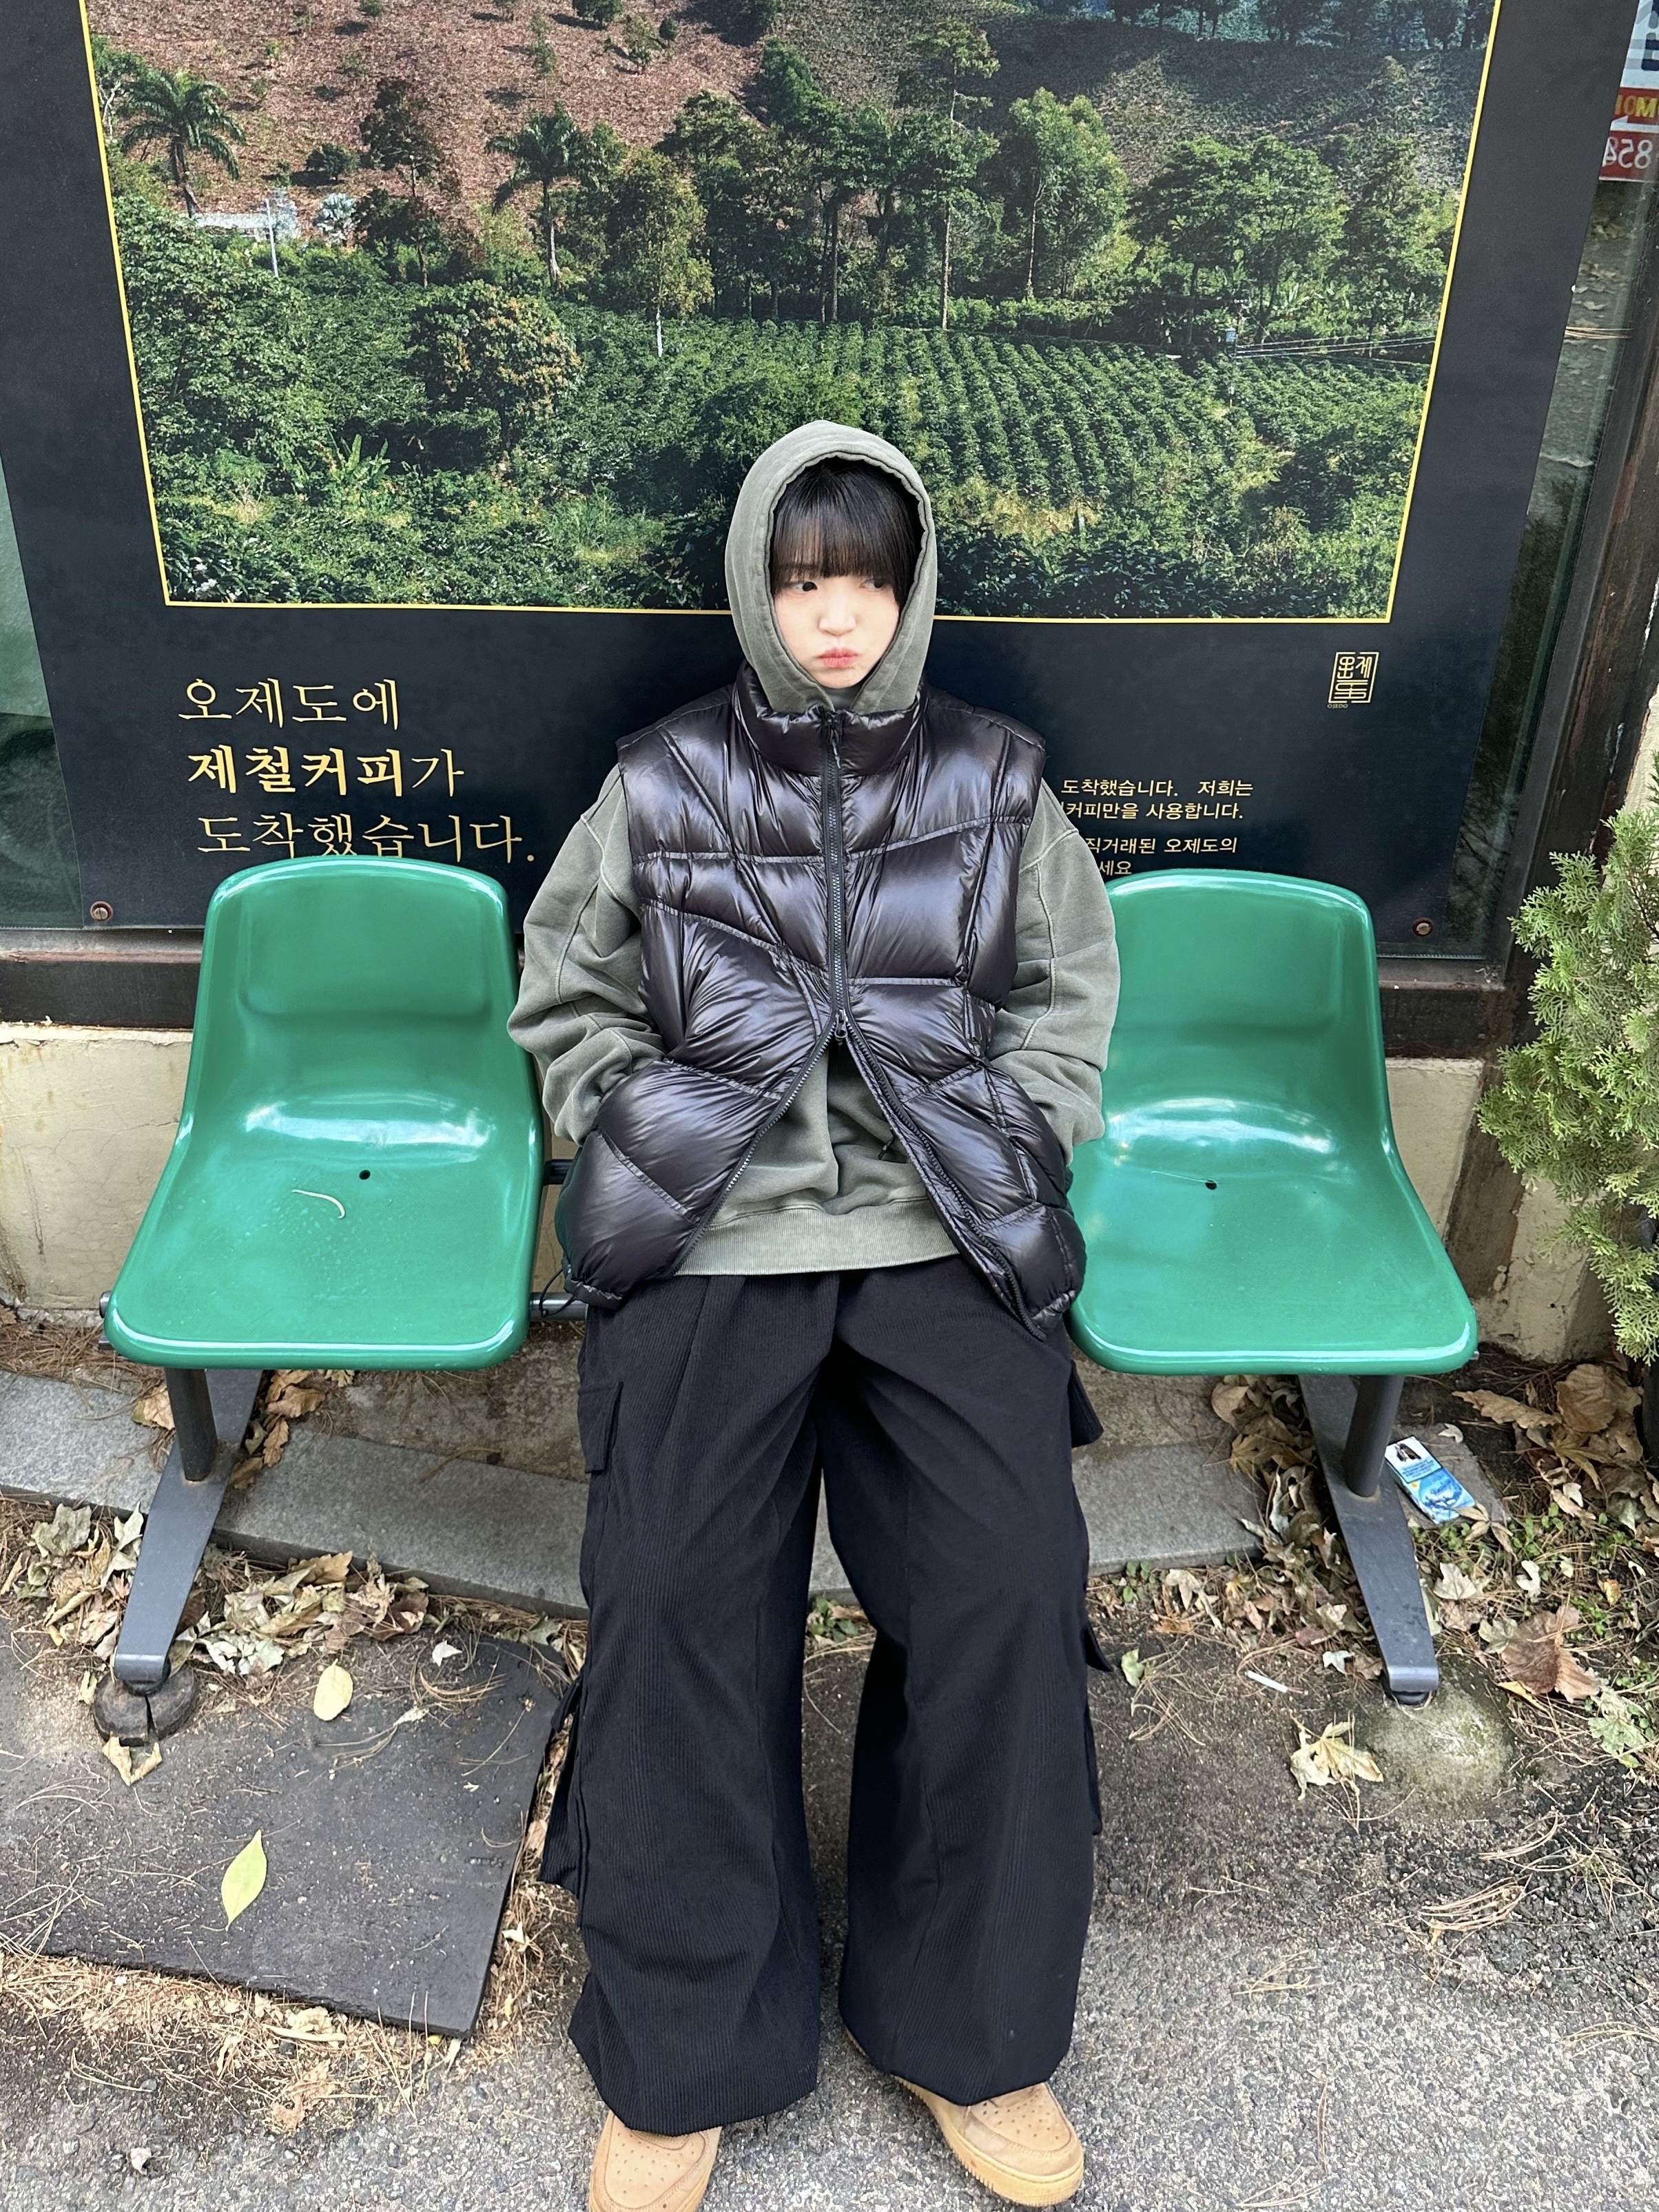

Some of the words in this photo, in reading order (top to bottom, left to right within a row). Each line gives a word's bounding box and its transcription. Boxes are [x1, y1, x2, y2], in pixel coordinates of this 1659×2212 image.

[178, 678, 398, 730] 오제도에
[187, 744, 464, 797] 제철커피가
[1061, 778, 1178, 797] 도착했습니다.
[1197, 779, 1254, 797] 저희는
[1061, 801, 1139, 820] 커피만을
[1146, 802, 1243, 820] 사용합니다.
[198, 812, 535, 863] 도착했습니다.
[1086, 837, 1156, 855] 직거래된
[1164, 837, 1237, 854] 오제도의
